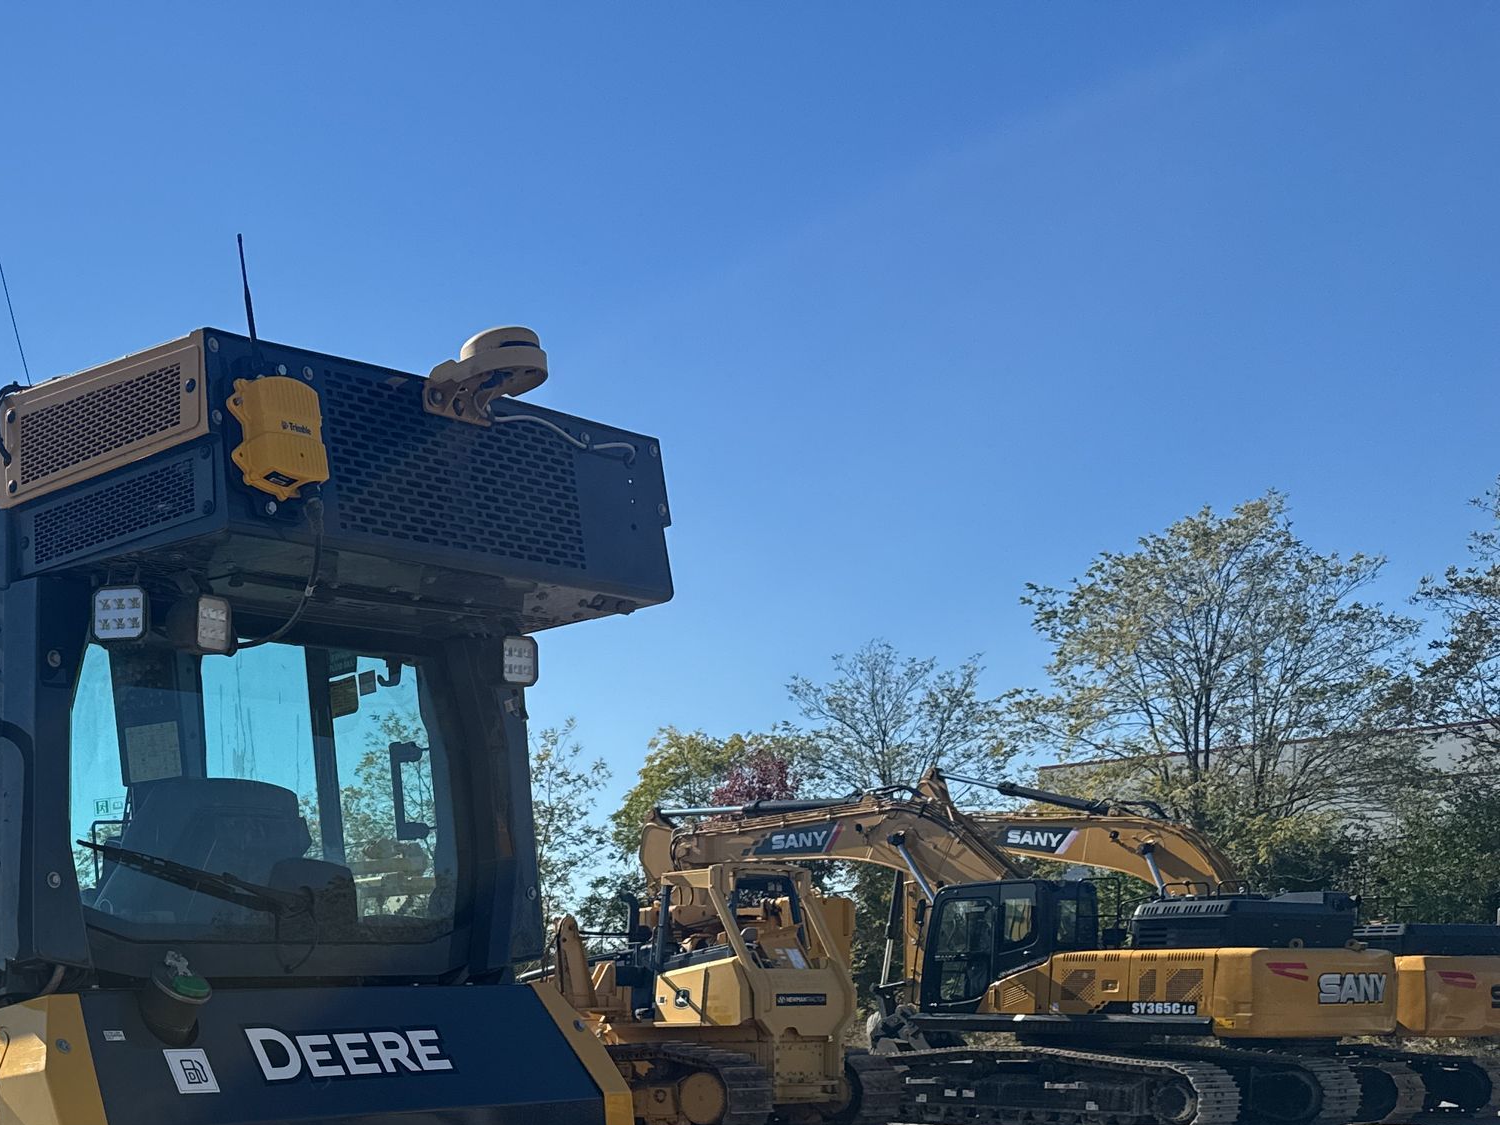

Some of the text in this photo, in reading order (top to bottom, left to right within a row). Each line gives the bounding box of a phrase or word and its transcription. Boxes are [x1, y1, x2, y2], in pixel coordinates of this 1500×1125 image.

[289, 422, 312, 436] Trimble
[771, 830, 828, 850] SANY
[1006, 829, 1063, 848] SANY
[1319, 973, 1387, 1004] SANY
[1131, 1002, 1196, 1015] SY365C LC
[244, 1027, 454, 1081] DEERE
